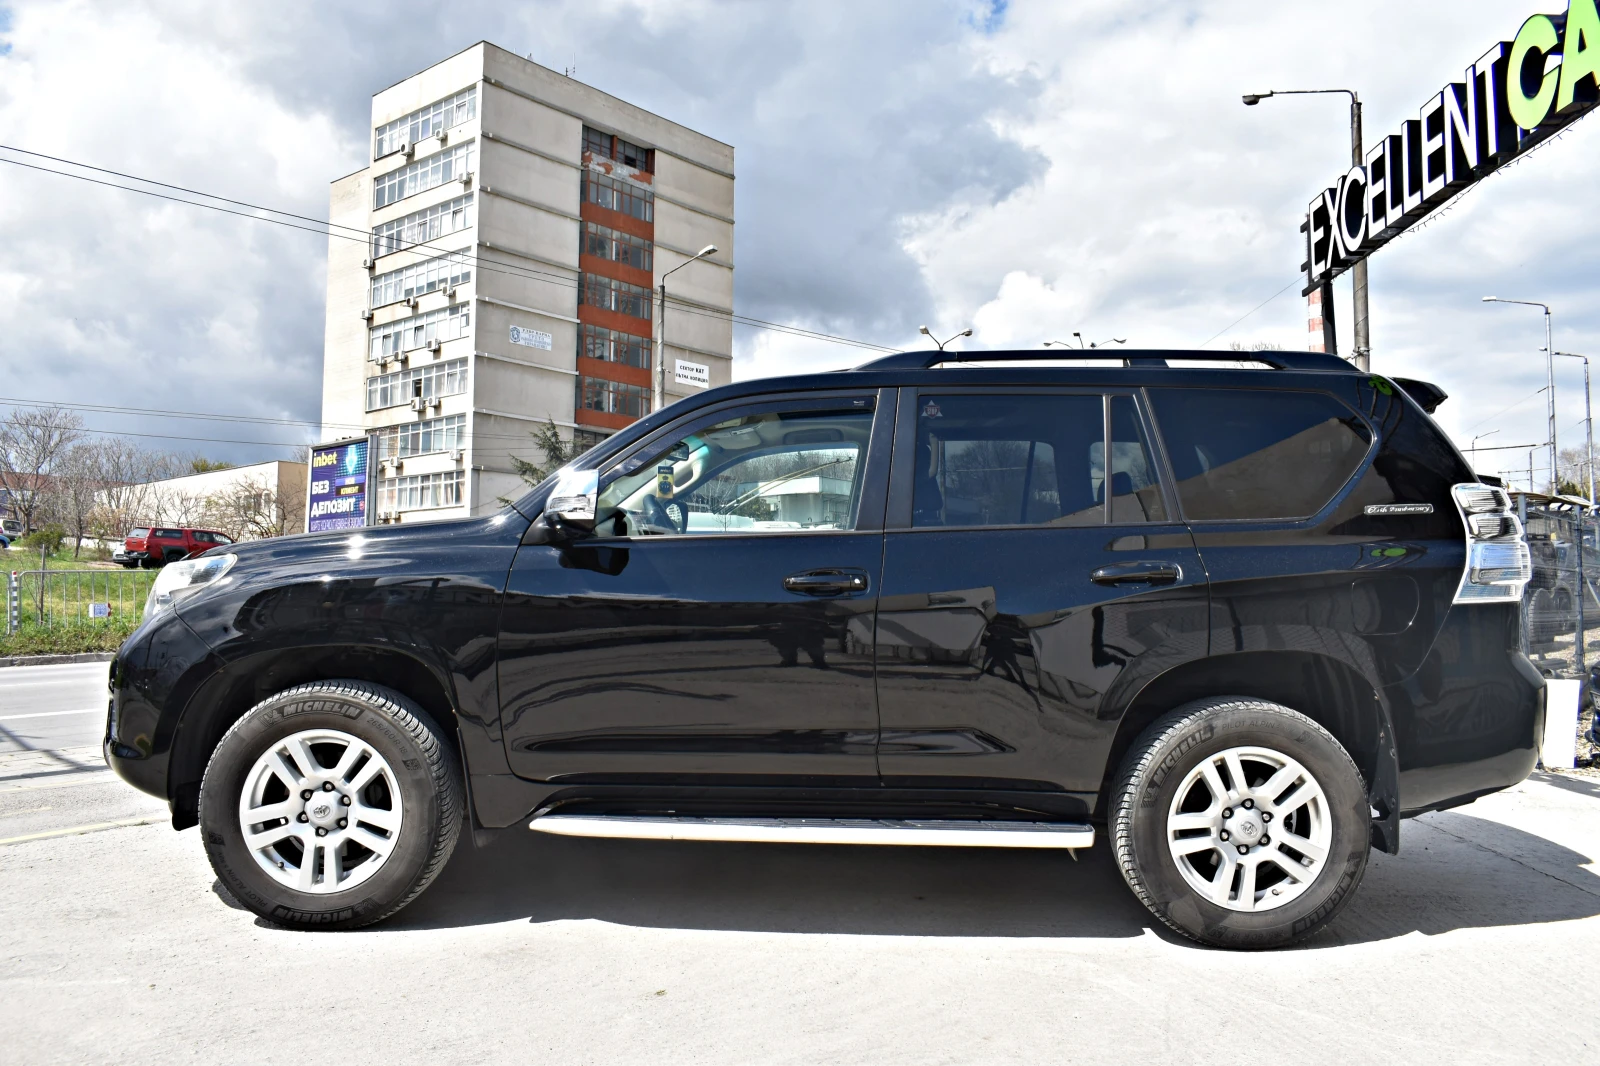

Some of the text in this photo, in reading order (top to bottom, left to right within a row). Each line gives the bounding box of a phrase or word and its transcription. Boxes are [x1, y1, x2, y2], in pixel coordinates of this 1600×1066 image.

[1309, 41, 1502, 280] EXCELLENT
[313, 452, 338, 468] inbet
[311, 480, 330, 495] БЕЗ
[311, 498, 356, 518] ДЕПОЗИТ
[283, 701, 361, 717] MICHELIN
[367, 717, 396, 740] 265/60
[1222, 720, 1246, 731] PILOT
[1248, 720, 1276, 730] ALPIN
[1153, 727, 1212, 786] MICHELIN
[244, 890, 268, 908] PILOT
[1295, 873, 1352, 934] MICHELIN
[273, 906, 353, 923] MICHELIN
